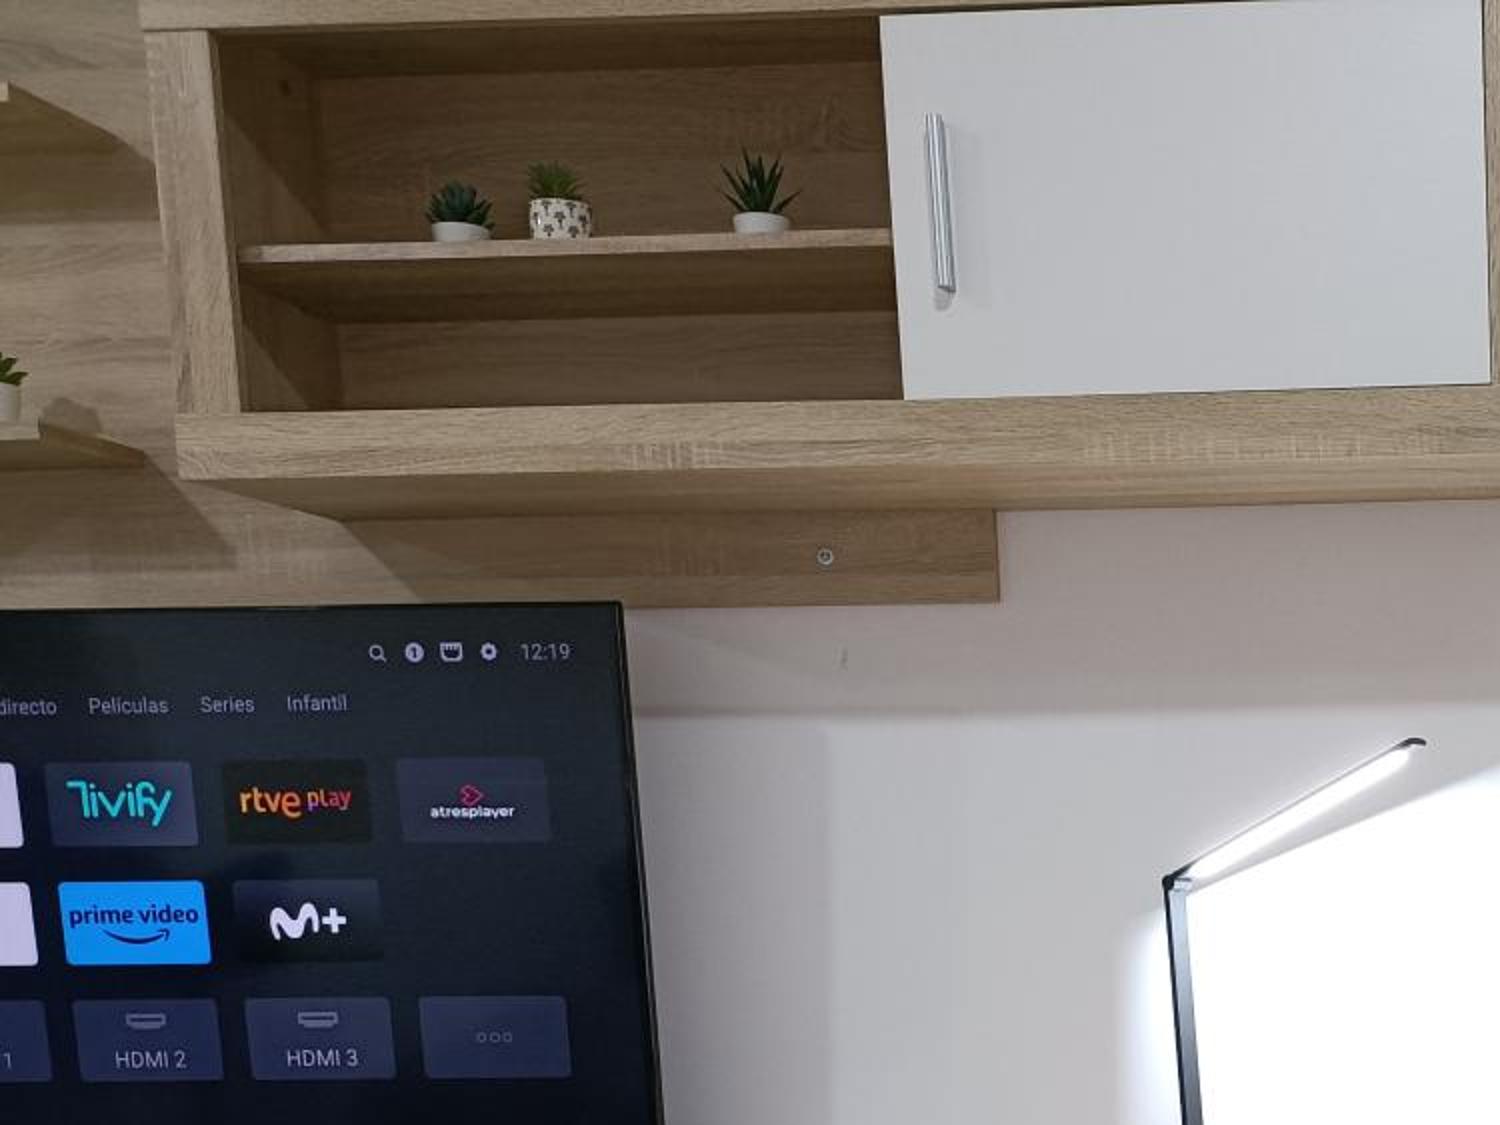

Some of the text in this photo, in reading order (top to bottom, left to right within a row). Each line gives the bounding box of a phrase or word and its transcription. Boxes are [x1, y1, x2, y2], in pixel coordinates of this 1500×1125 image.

[521, 643, 570, 661] 12:19
[200, 696, 255, 713] Series
[287, 693, 348, 712] Infantil
[239, 787, 351, 818] rtve play
[430, 805, 515, 819] atresplayer
[69, 904, 199, 929] prime video
[3, 1053, 12, 1069] 1
[115, 1051, 188, 1069] HDMI 2
[286, 1049, 359, 1067] HDMI 3
